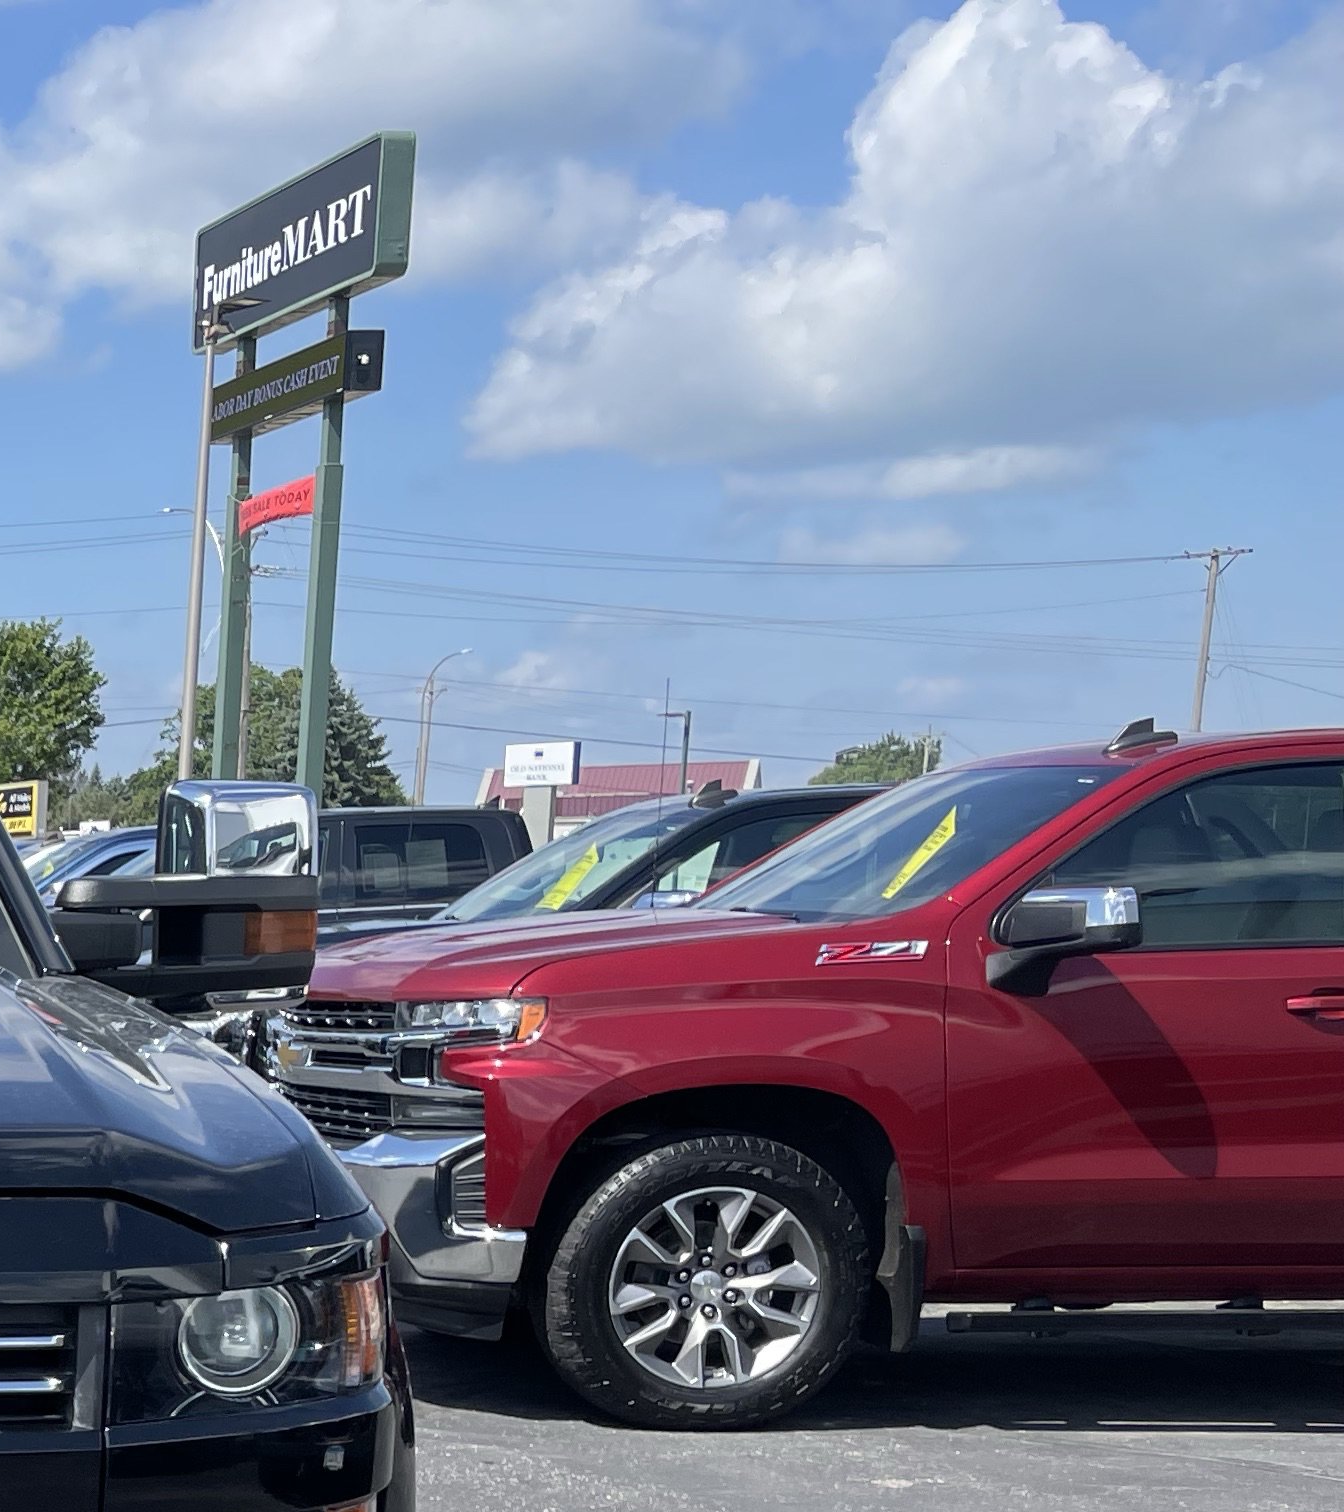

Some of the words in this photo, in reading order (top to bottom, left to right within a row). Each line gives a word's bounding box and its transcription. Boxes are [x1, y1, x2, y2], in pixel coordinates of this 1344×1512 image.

[211, 398, 235, 422] ABOR
[235, 390, 253, 413] DAY
[253, 378, 283, 406] BONUS
[284, 368, 307, 394] CASH
[308, 355, 340, 383] EVENT
[275, 488, 310, 507] TODAY
[815, 940, 929, 967] Z71
